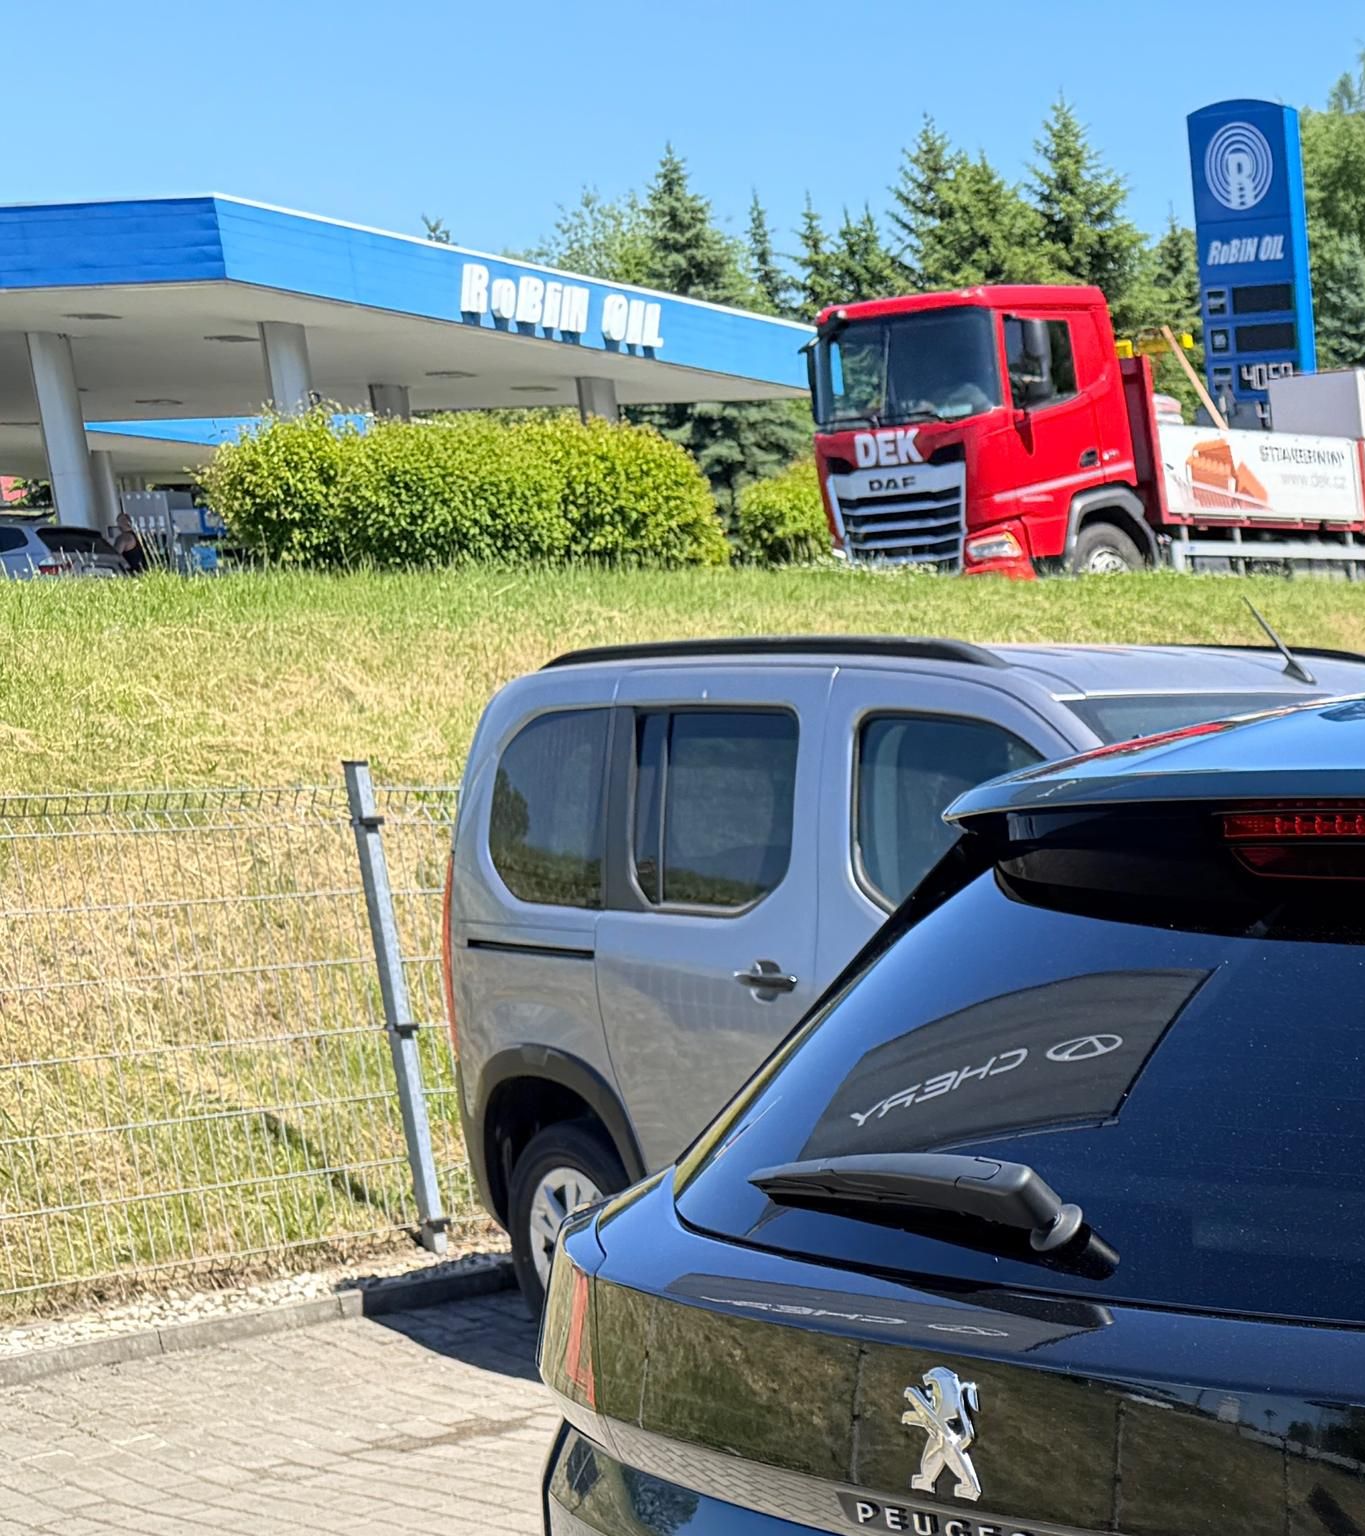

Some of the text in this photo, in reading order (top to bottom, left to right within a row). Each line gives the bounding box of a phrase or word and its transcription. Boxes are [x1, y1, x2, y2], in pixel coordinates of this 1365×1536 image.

[1259, 234, 1285, 262] OIL
[602, 294, 664, 348] OIL
[854, 428, 924, 468] DEK
[868, 476, 916, 492] DAF
